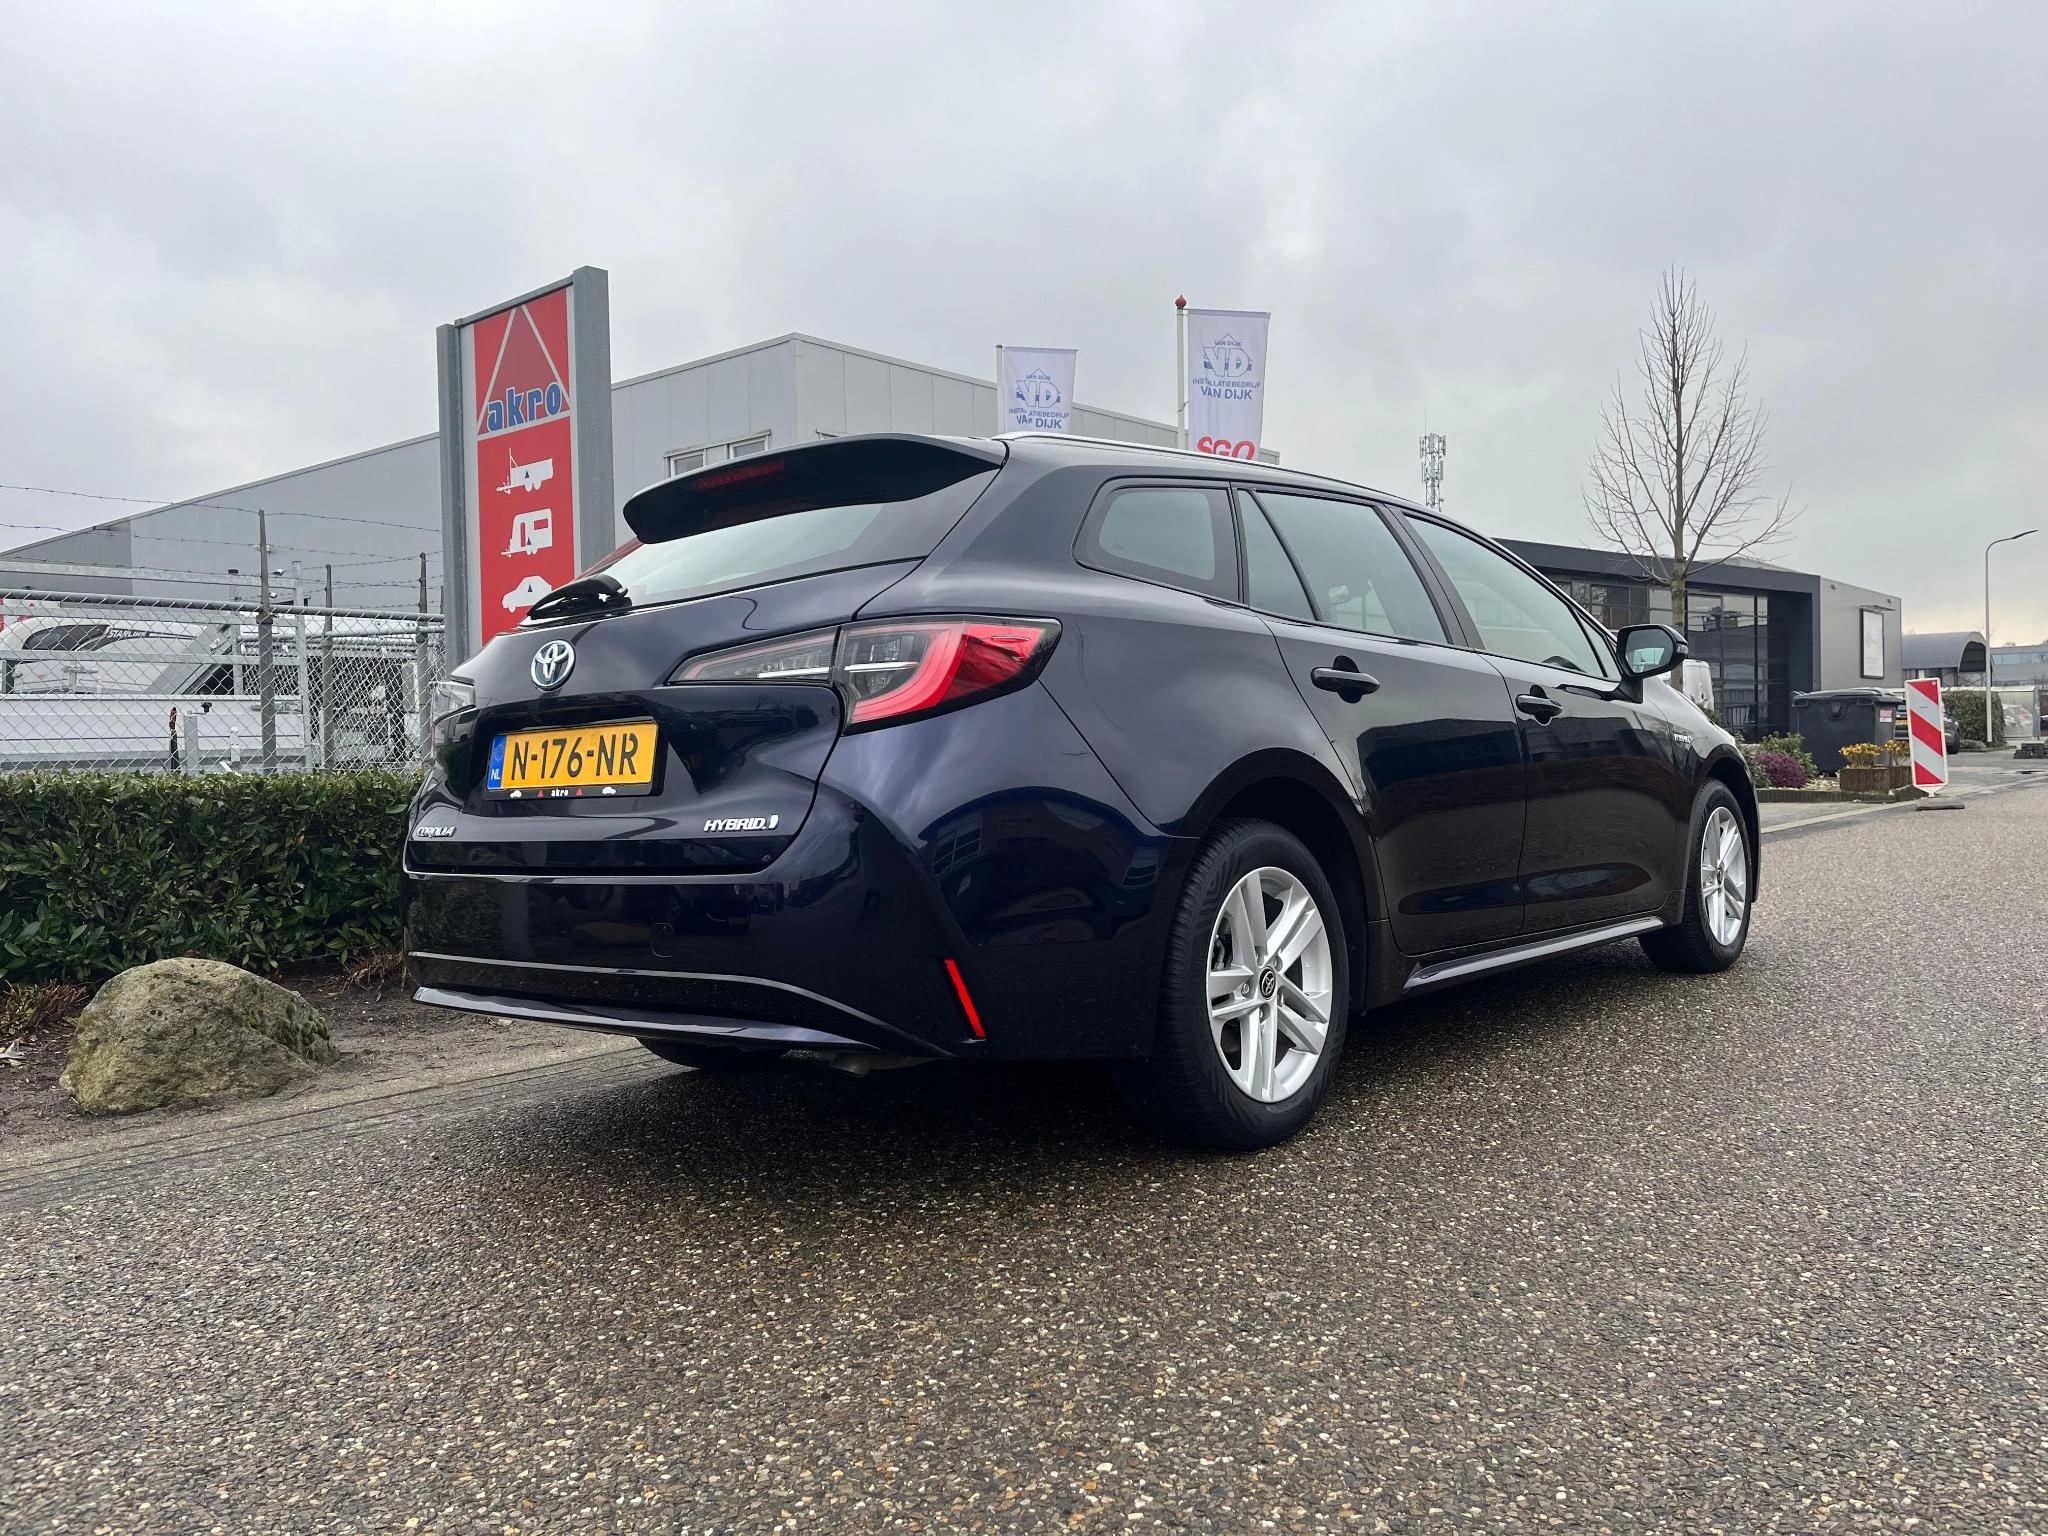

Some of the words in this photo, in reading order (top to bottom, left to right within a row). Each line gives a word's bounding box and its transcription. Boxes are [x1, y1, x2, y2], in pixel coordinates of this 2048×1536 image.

[1201, 385, 1222, 399] VAN
[1225, 389, 1253, 400] DIJK
[486, 381, 562, 432] akro
[1008, 407, 1070, 419] INSTAATIEBEDRIJF
[1035, 417, 1062, 429] DIJK
[511, 732, 639, 781] N-176-NR
[490, 768, 501, 780] NL
[551, 788, 569, 797] akro
